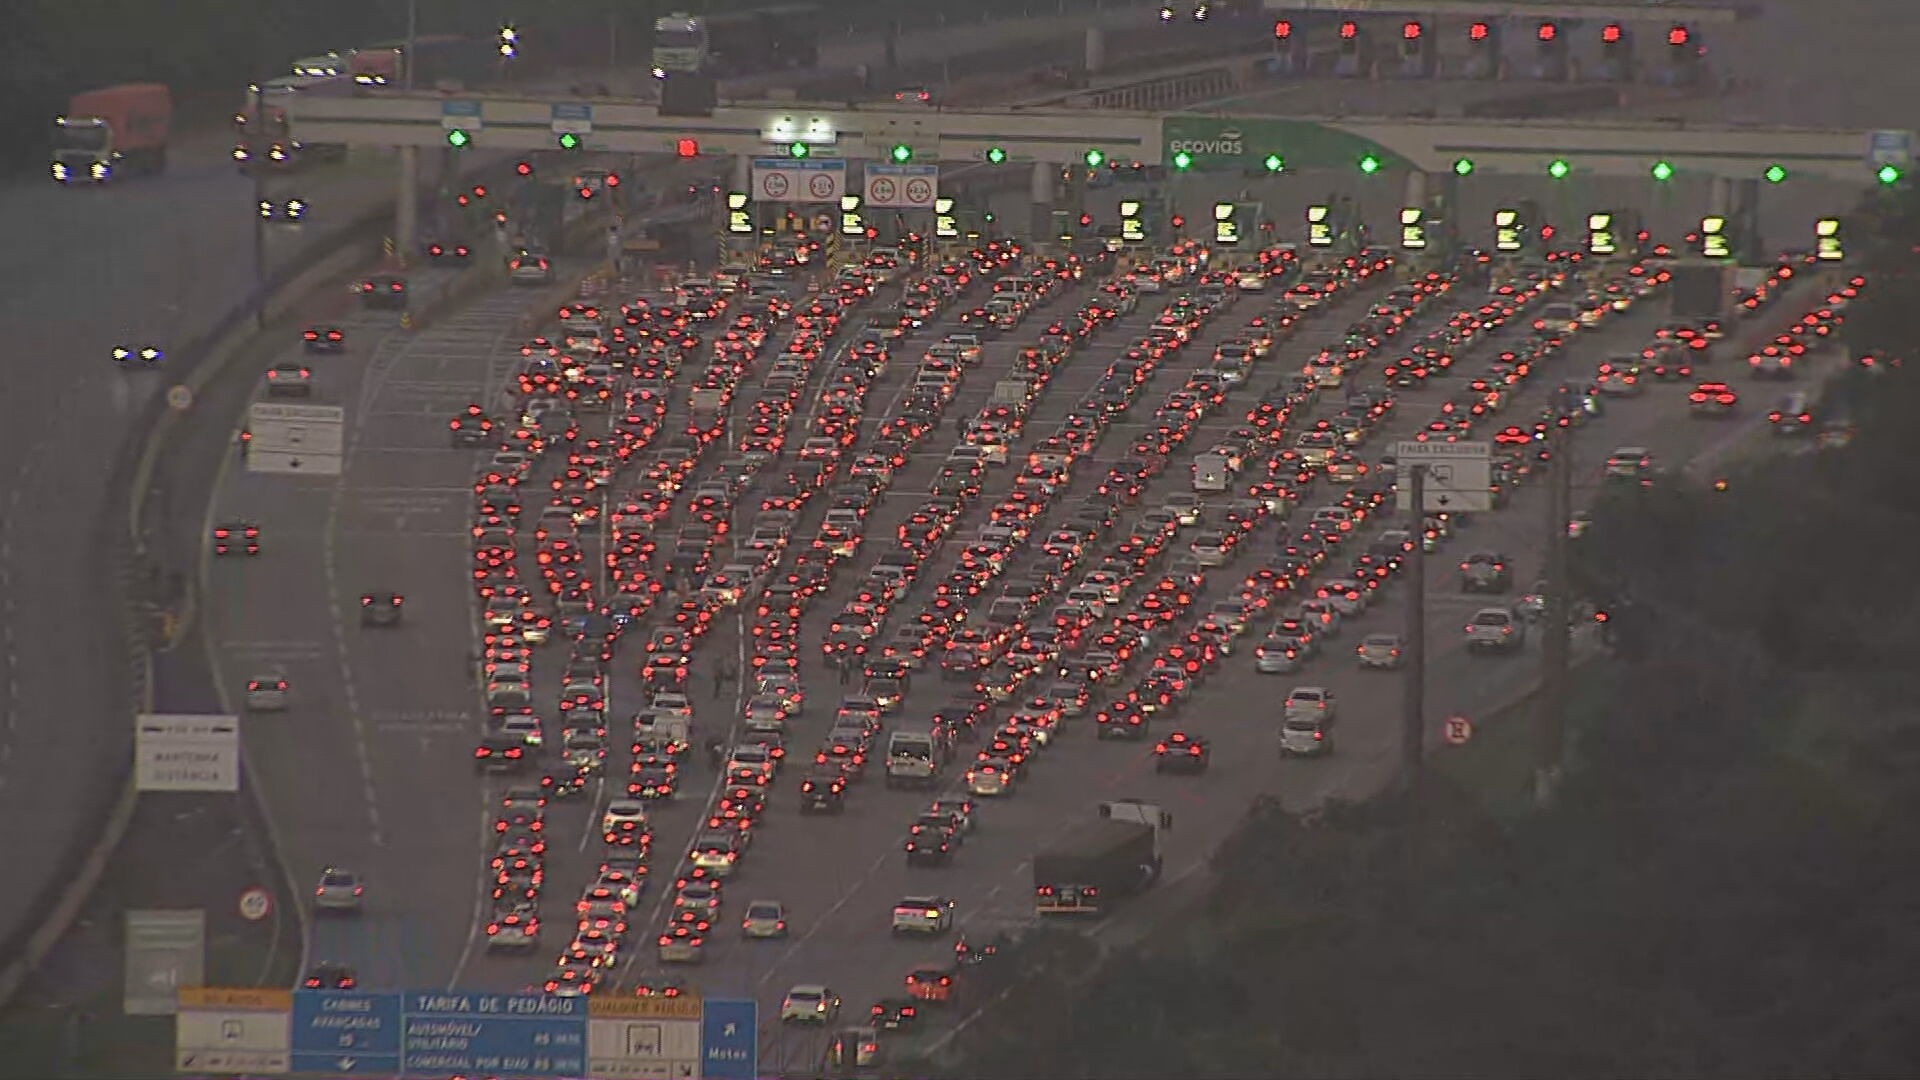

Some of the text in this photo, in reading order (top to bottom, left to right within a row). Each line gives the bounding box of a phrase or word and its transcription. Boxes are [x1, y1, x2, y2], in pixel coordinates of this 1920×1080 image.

[1170, 138, 1242, 154] ecovias
[418, 995, 573, 1014] TARIFA DE PEDÁGIO
